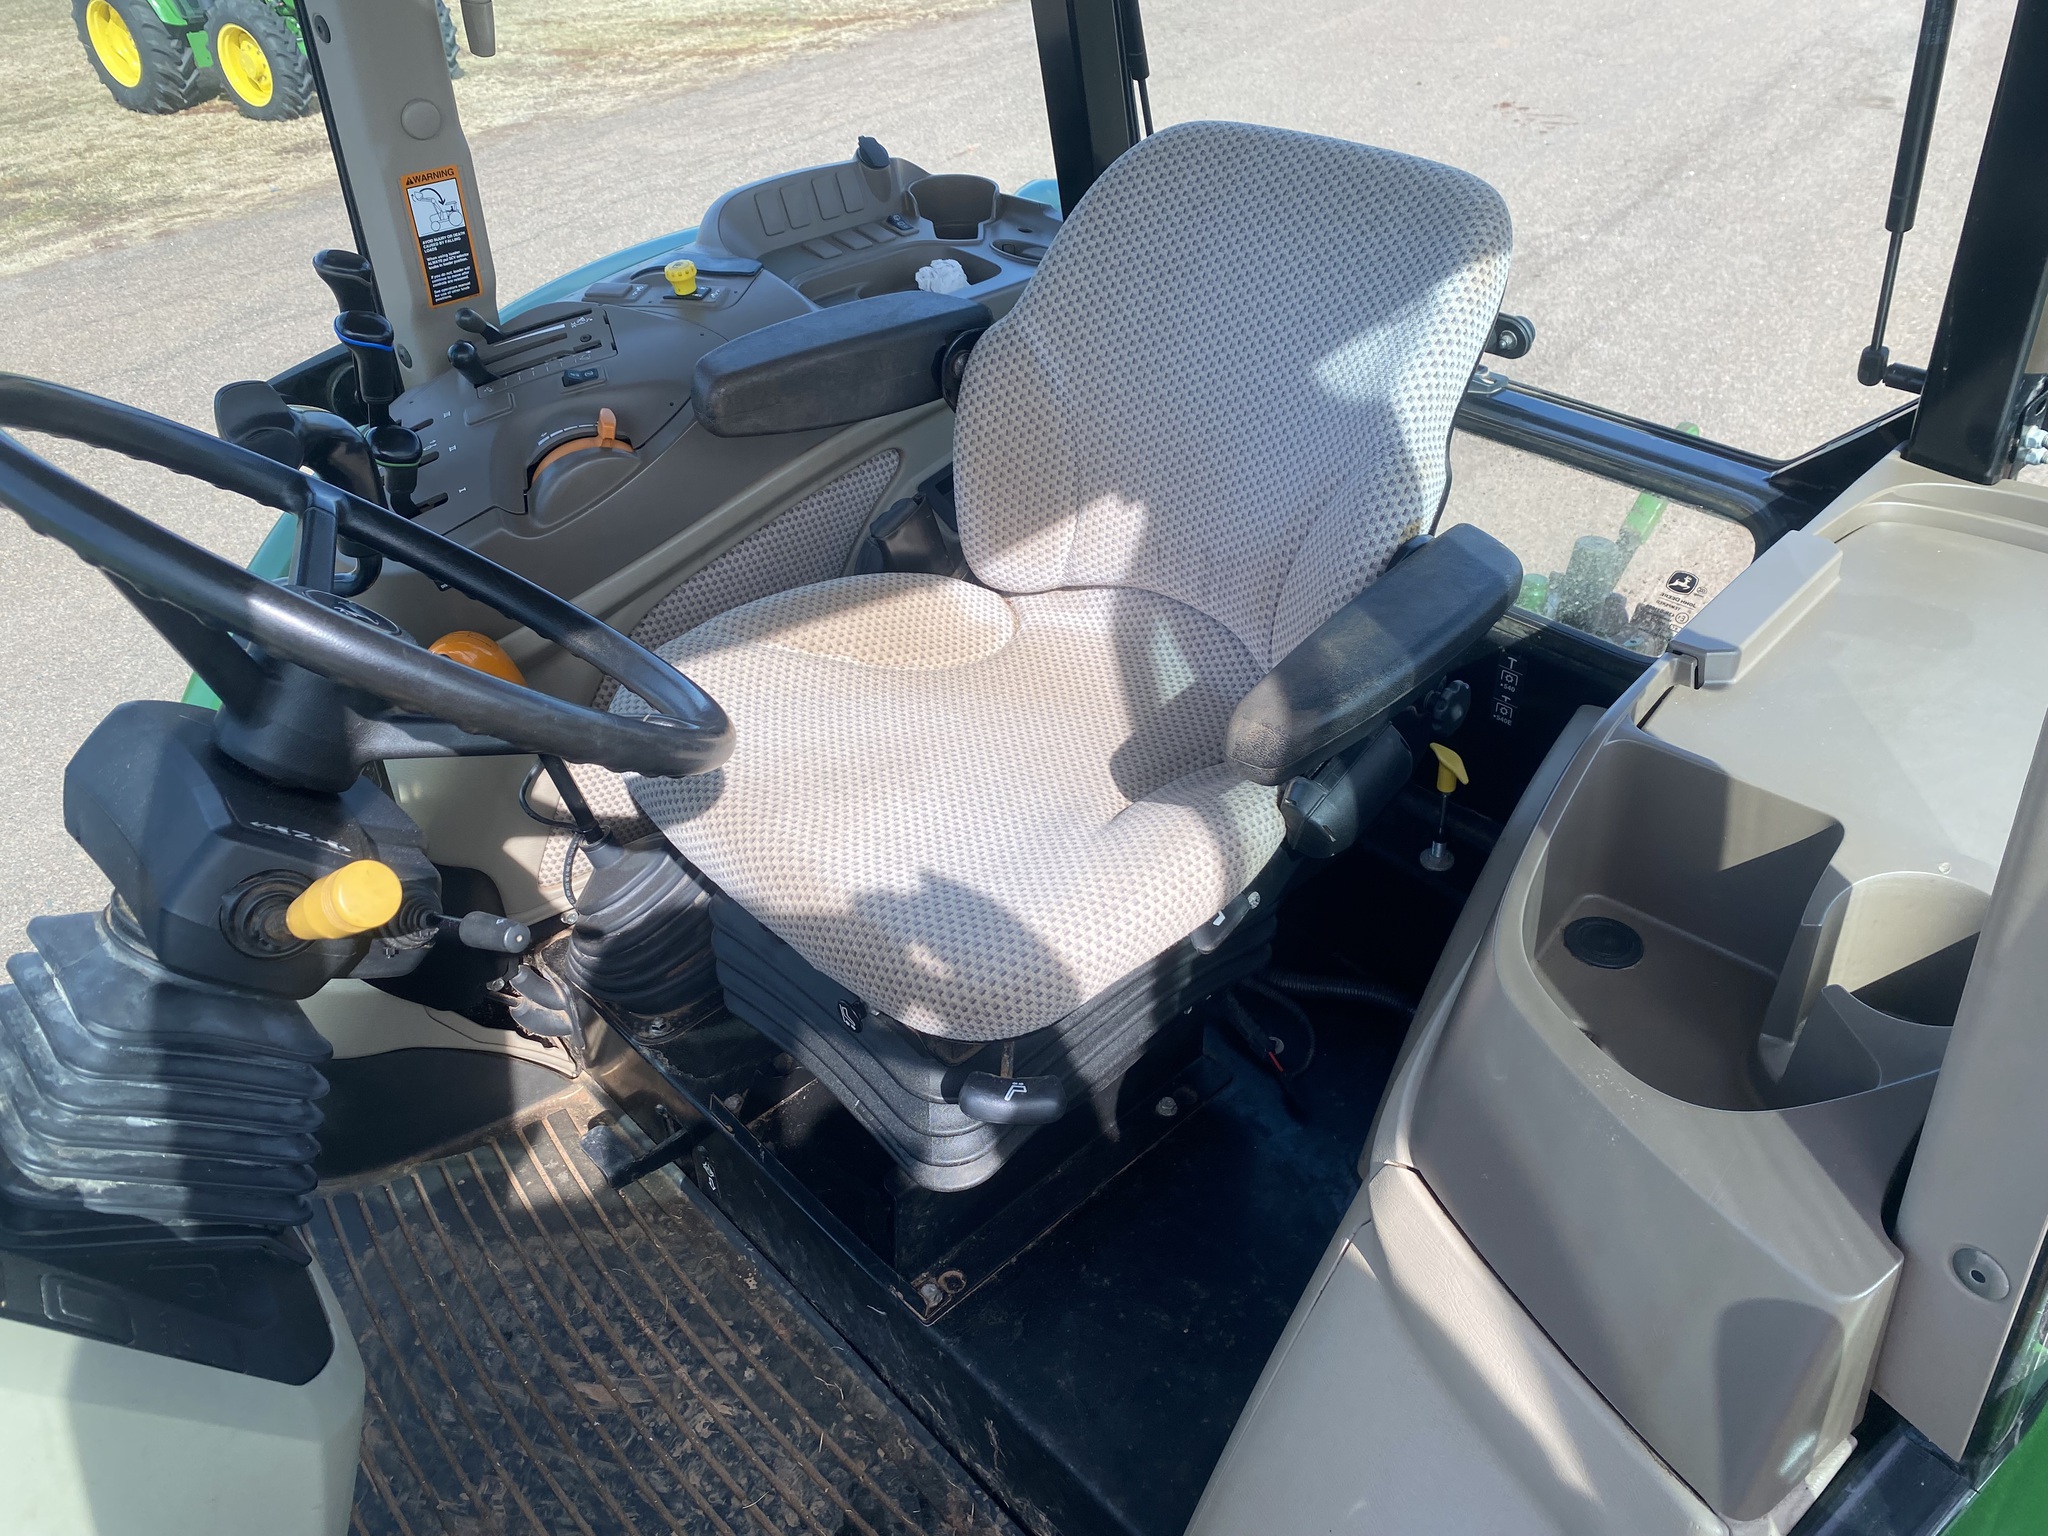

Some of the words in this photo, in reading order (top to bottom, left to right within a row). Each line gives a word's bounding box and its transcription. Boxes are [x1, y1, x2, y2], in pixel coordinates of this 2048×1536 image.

[412, 168, 455, 185] WARNING
[1503, 684, 1516, 693] 540
[1496, 715, 1512, 726] 540E
